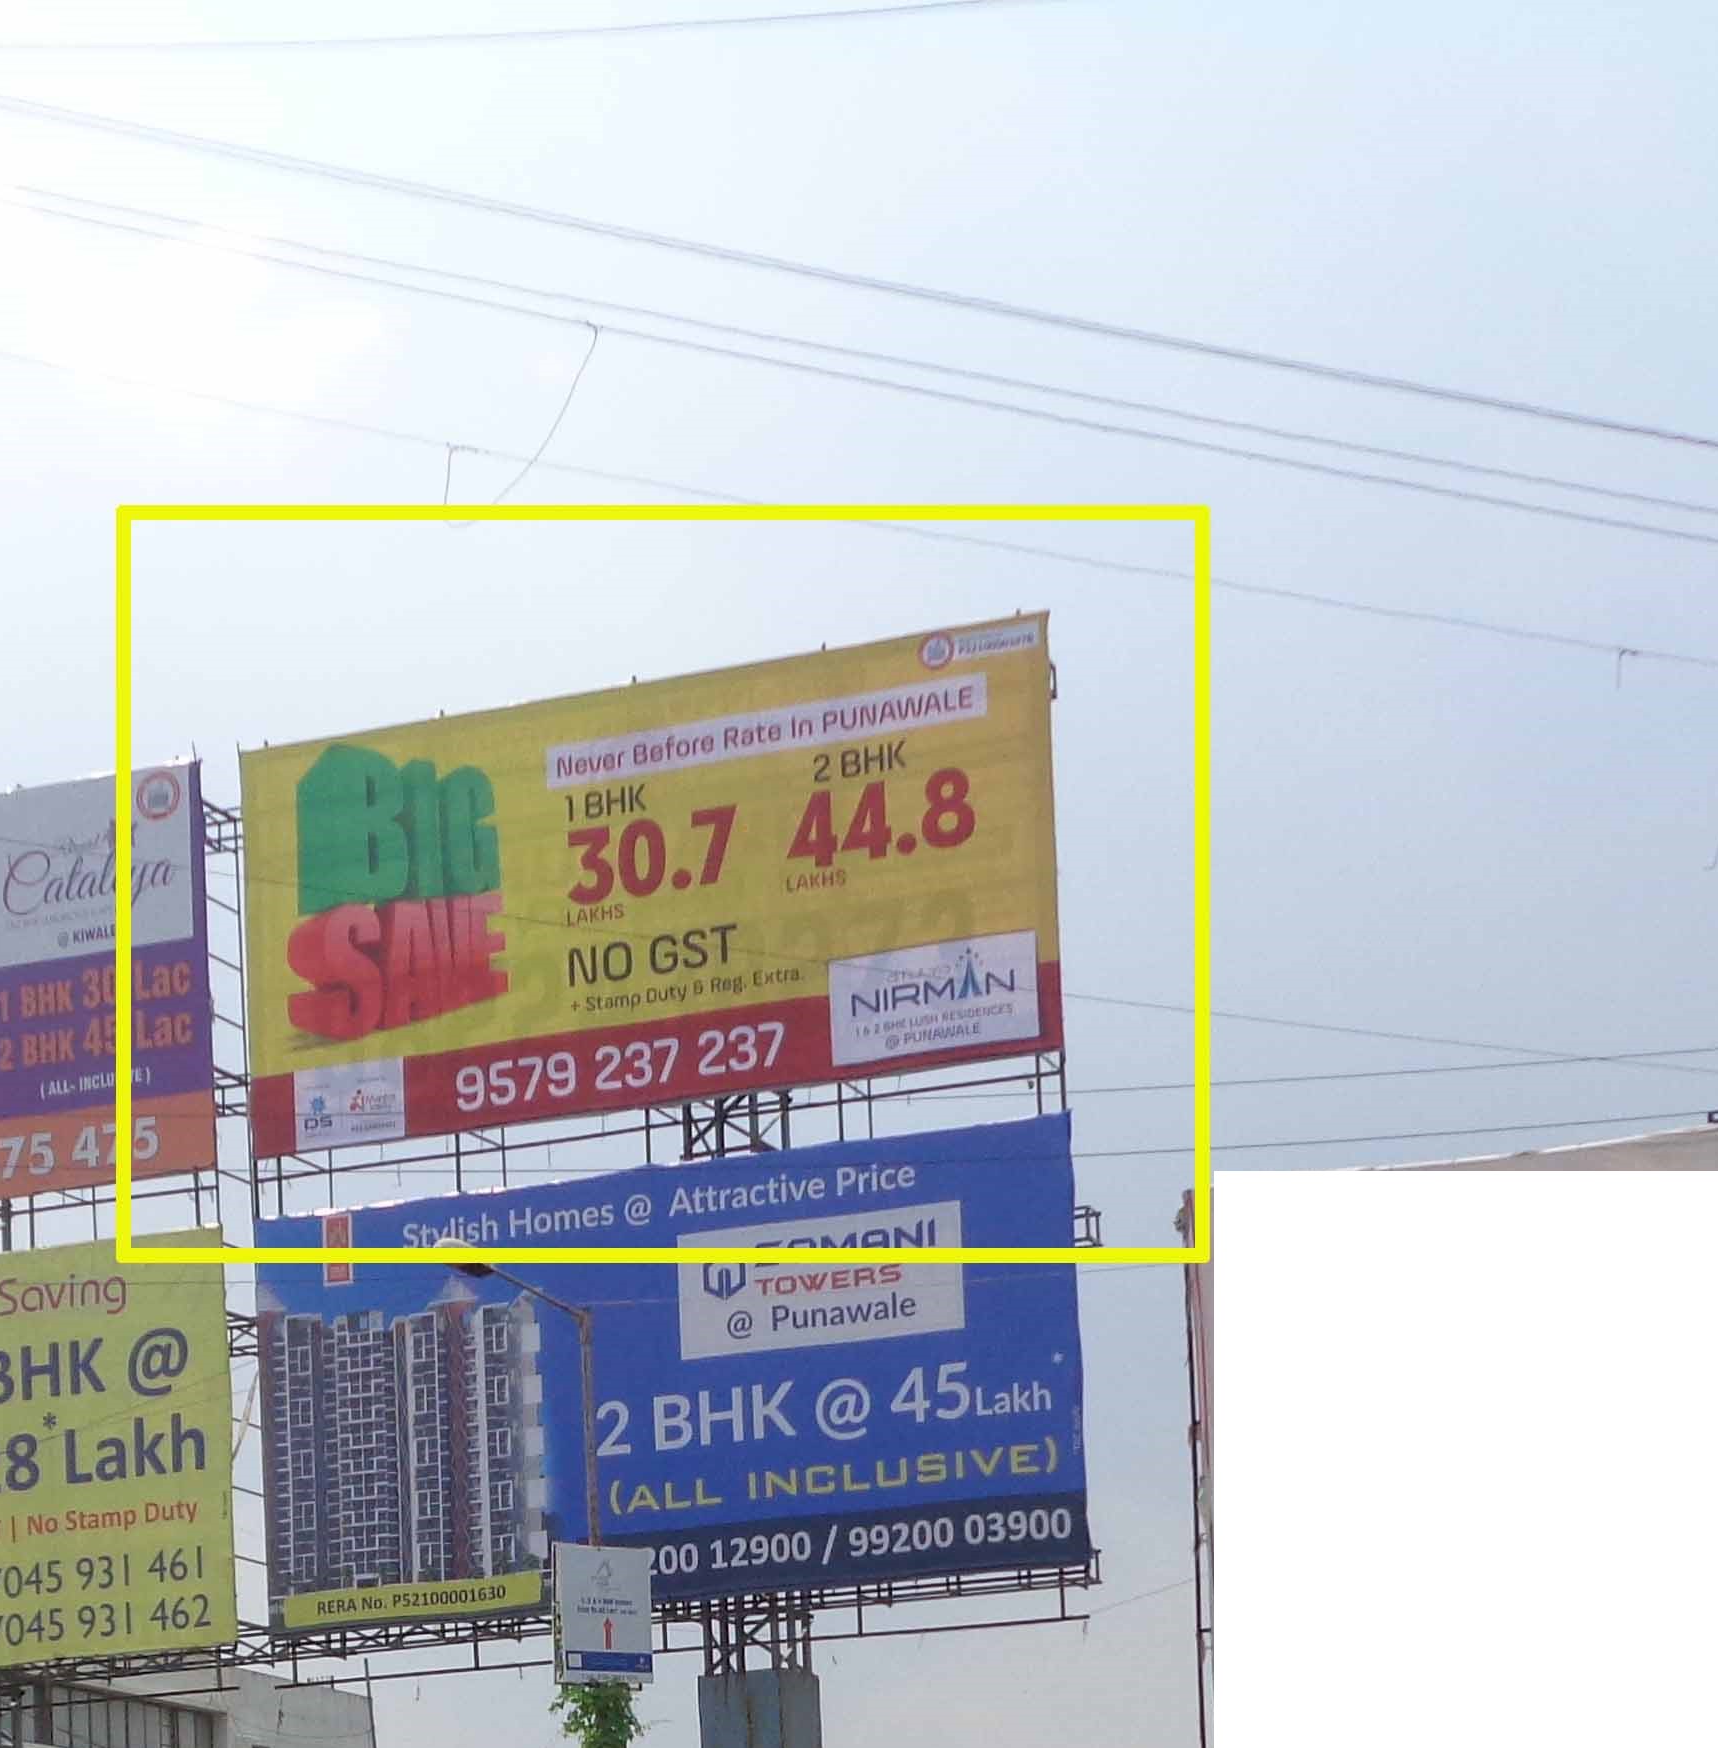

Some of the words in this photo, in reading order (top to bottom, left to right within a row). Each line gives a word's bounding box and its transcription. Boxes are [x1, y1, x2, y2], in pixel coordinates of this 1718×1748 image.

[556, 749, 625, 780] Never
[633, 735, 715, 766] Before
[723, 724, 782, 751] Rate
[791, 713, 814, 739] In
[822, 685, 974, 733] PUNAWALE
[841, 739, 907, 780] BHK
[585, 783, 647, 820] BHK
[787, 766, 977, 868] 44.8
[296, 742, 502, 917] BIG
[567, 803, 738, 906] 30.7
[786, 869, 847, 893] LAKHS
[567, 904, 625, 928] LAKHS
[567, 941, 633, 988] NO
[649, 923, 738, 975] GST
[19, 979, 76, 1019] BHK
[585, 985, 641, 1012] Stamp
[646, 978, 687, 1005] Duty
[710, 972, 747, 994] Reg.
[753, 967, 805, 988] Extra.
[22, 1029, 76, 1068] BHK
[903, 1022, 981, 1046] PUNAWALE
[455, 1051, 576, 1112] 9579
[594, 1037, 680, 1092] 237
[698, 1021, 785, 1077] 237
[509, 1202, 615, 1238] Homes
[668, 1173, 827, 1218] Attractive
[835, 1163, 916, 1197] Price
[755, 1263, 903, 1297] TOWERS
[771, 1291, 917, 1332] Punawale
[596, 1399, 631, 1456] 2
[653, 1379, 797, 1452] BHK
[63, 1411, 206, 1485] Lakh
[609, 1479, 723, 1516] (ALL
[748, 1436, 1059, 1500] INCLUSIVE)
[27, 1513, 58, 1537] No
[66, 1504, 136, 1533] Stamp
[144, 1500, 198, 1526] Duty
[709, 1530, 812, 1568] 12900
[849, 1518, 954, 1557] 99200
[964, 1507, 1072, 1546] 03900
[76, 1553, 131, 1591] 931
[148, 1545, 203, 1583] 461
[78, 1601, 132, 1639] 931
[149, 1593, 212, 1632] 462
[317, 1597, 358, 1616] RERA
[392, 1584, 507, 1610] P52100001630
